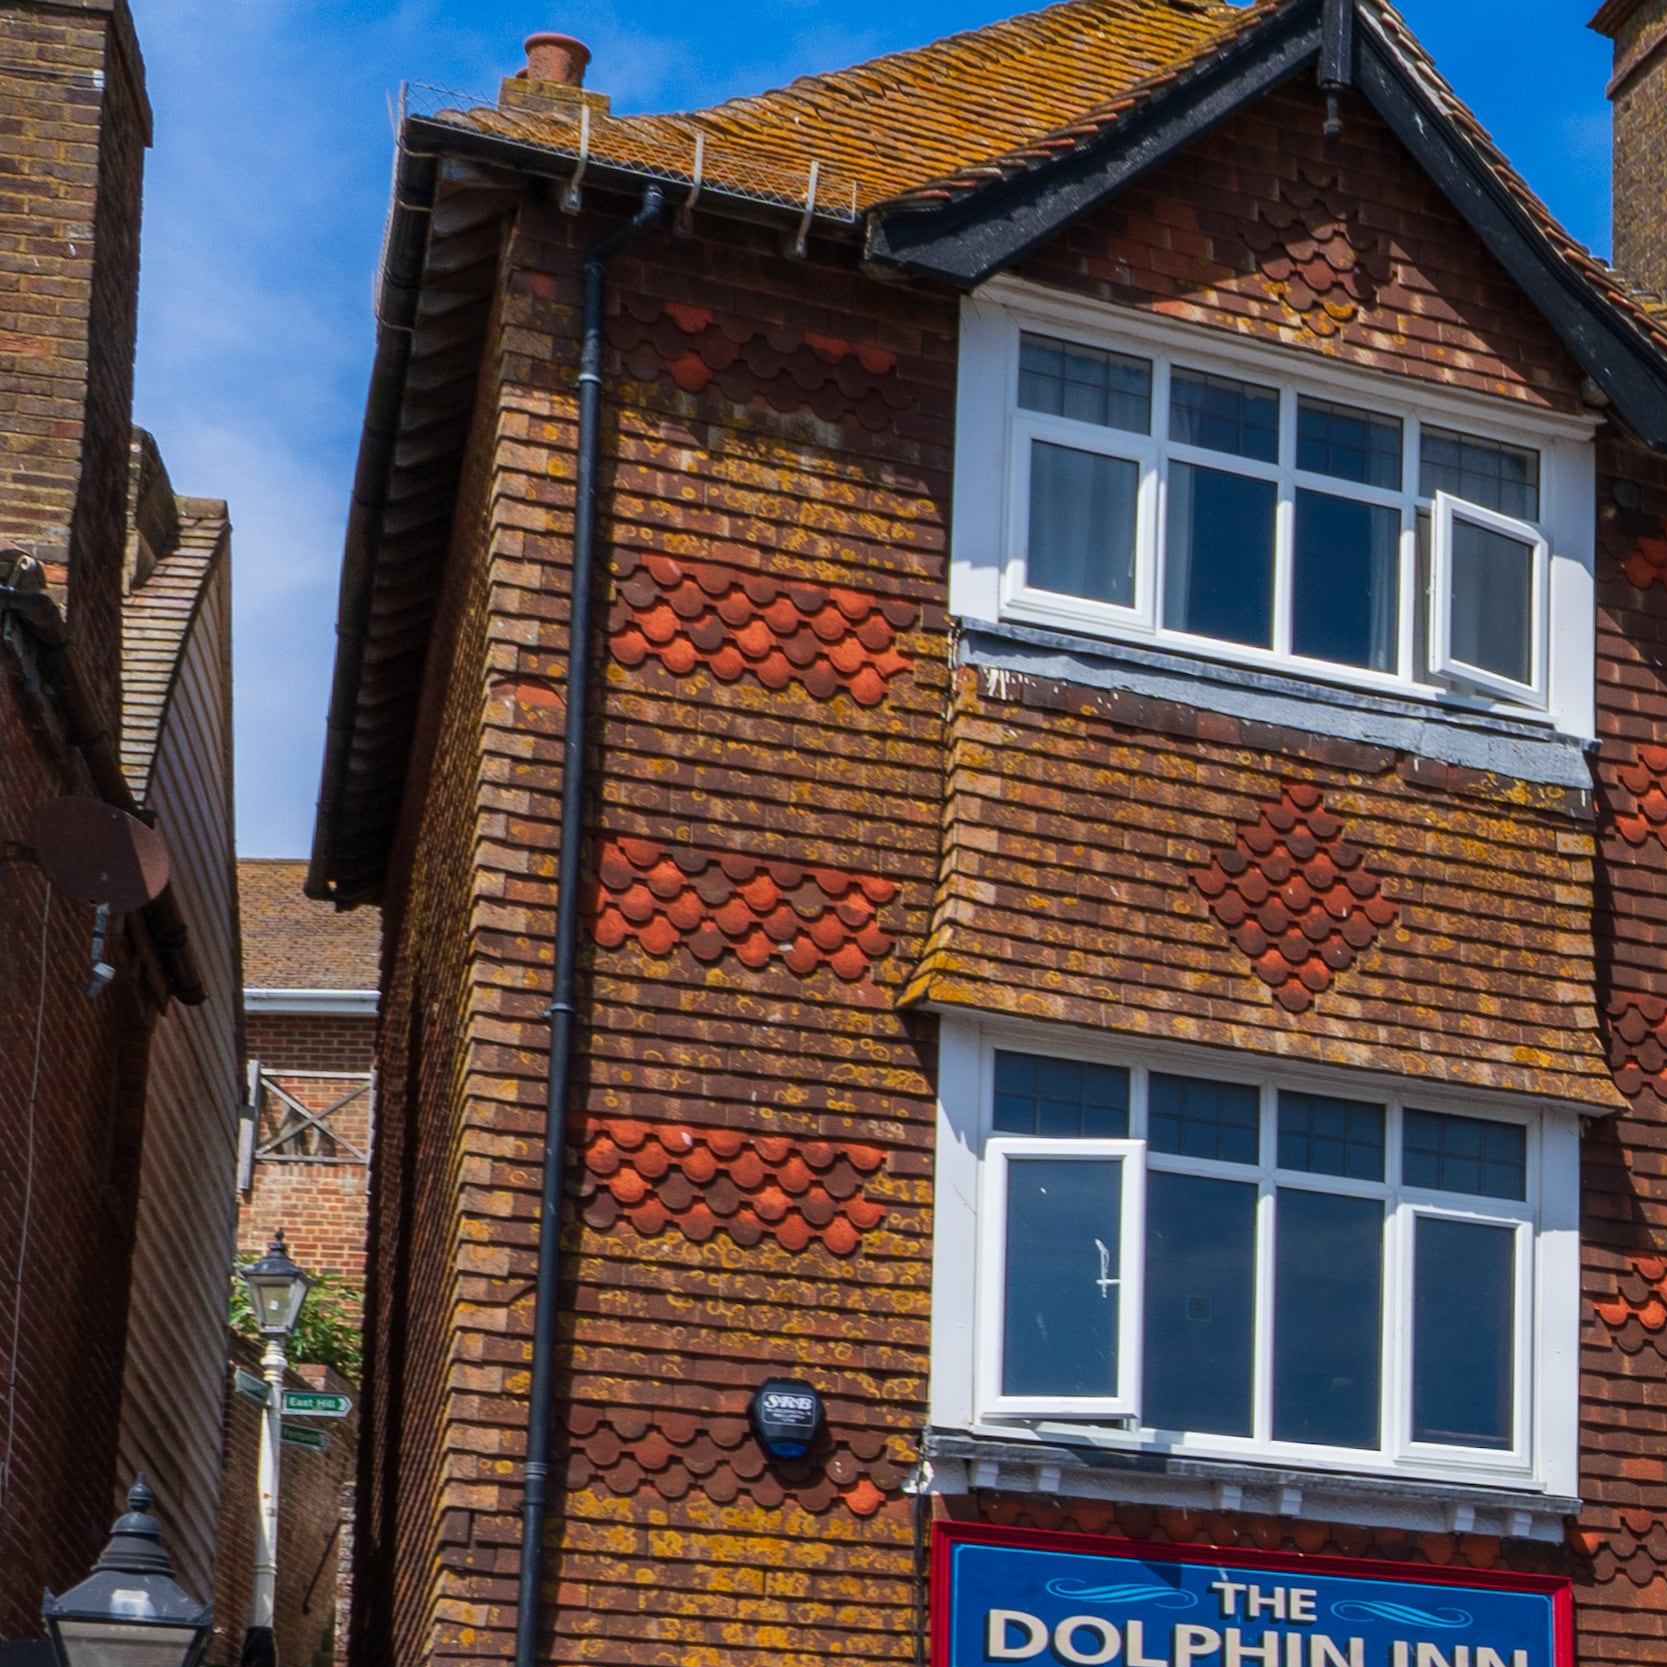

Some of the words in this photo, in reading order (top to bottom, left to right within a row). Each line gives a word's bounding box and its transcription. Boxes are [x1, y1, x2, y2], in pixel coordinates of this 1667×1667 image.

[289, 1397, 313, 1407] East
[317, 1398, 336, 1408] Hill
[1210, 1580, 1317, 1623] THE
